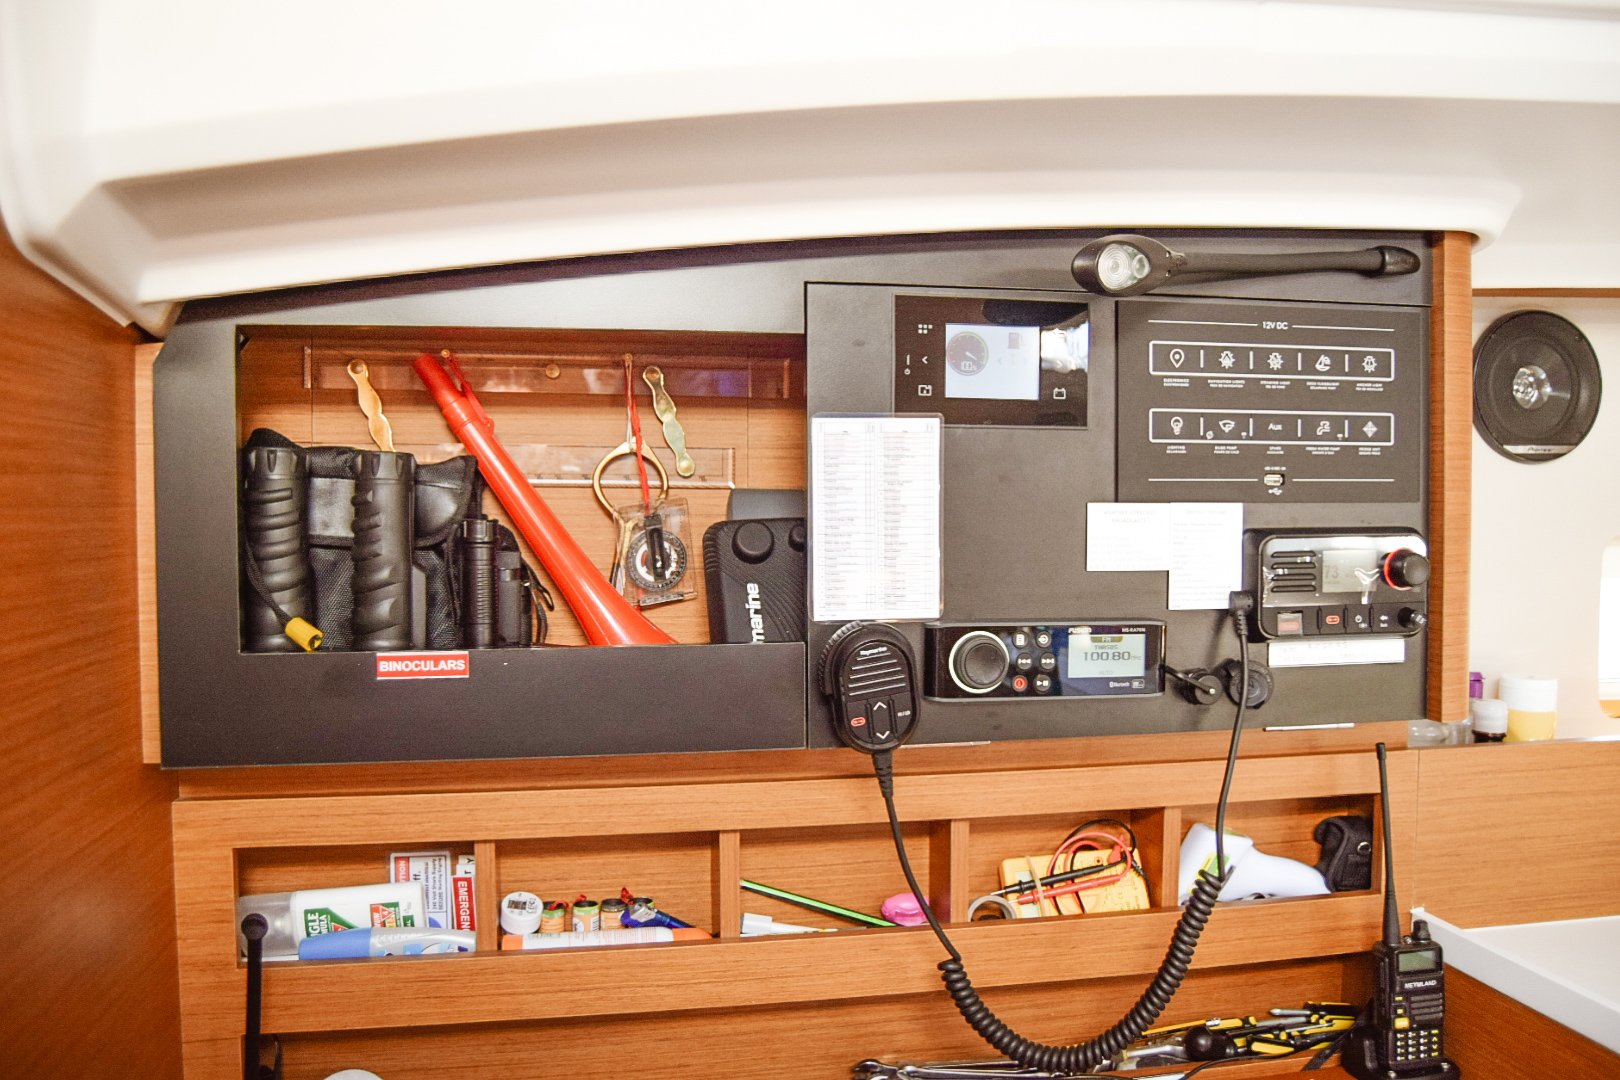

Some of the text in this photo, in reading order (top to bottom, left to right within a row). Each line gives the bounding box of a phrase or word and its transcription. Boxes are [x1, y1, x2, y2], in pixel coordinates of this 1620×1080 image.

[1276, 321, 1289, 330] DC
[1083, 651, 1131, 661] 100.80
[379, 659, 465, 673] BINOCULARS
